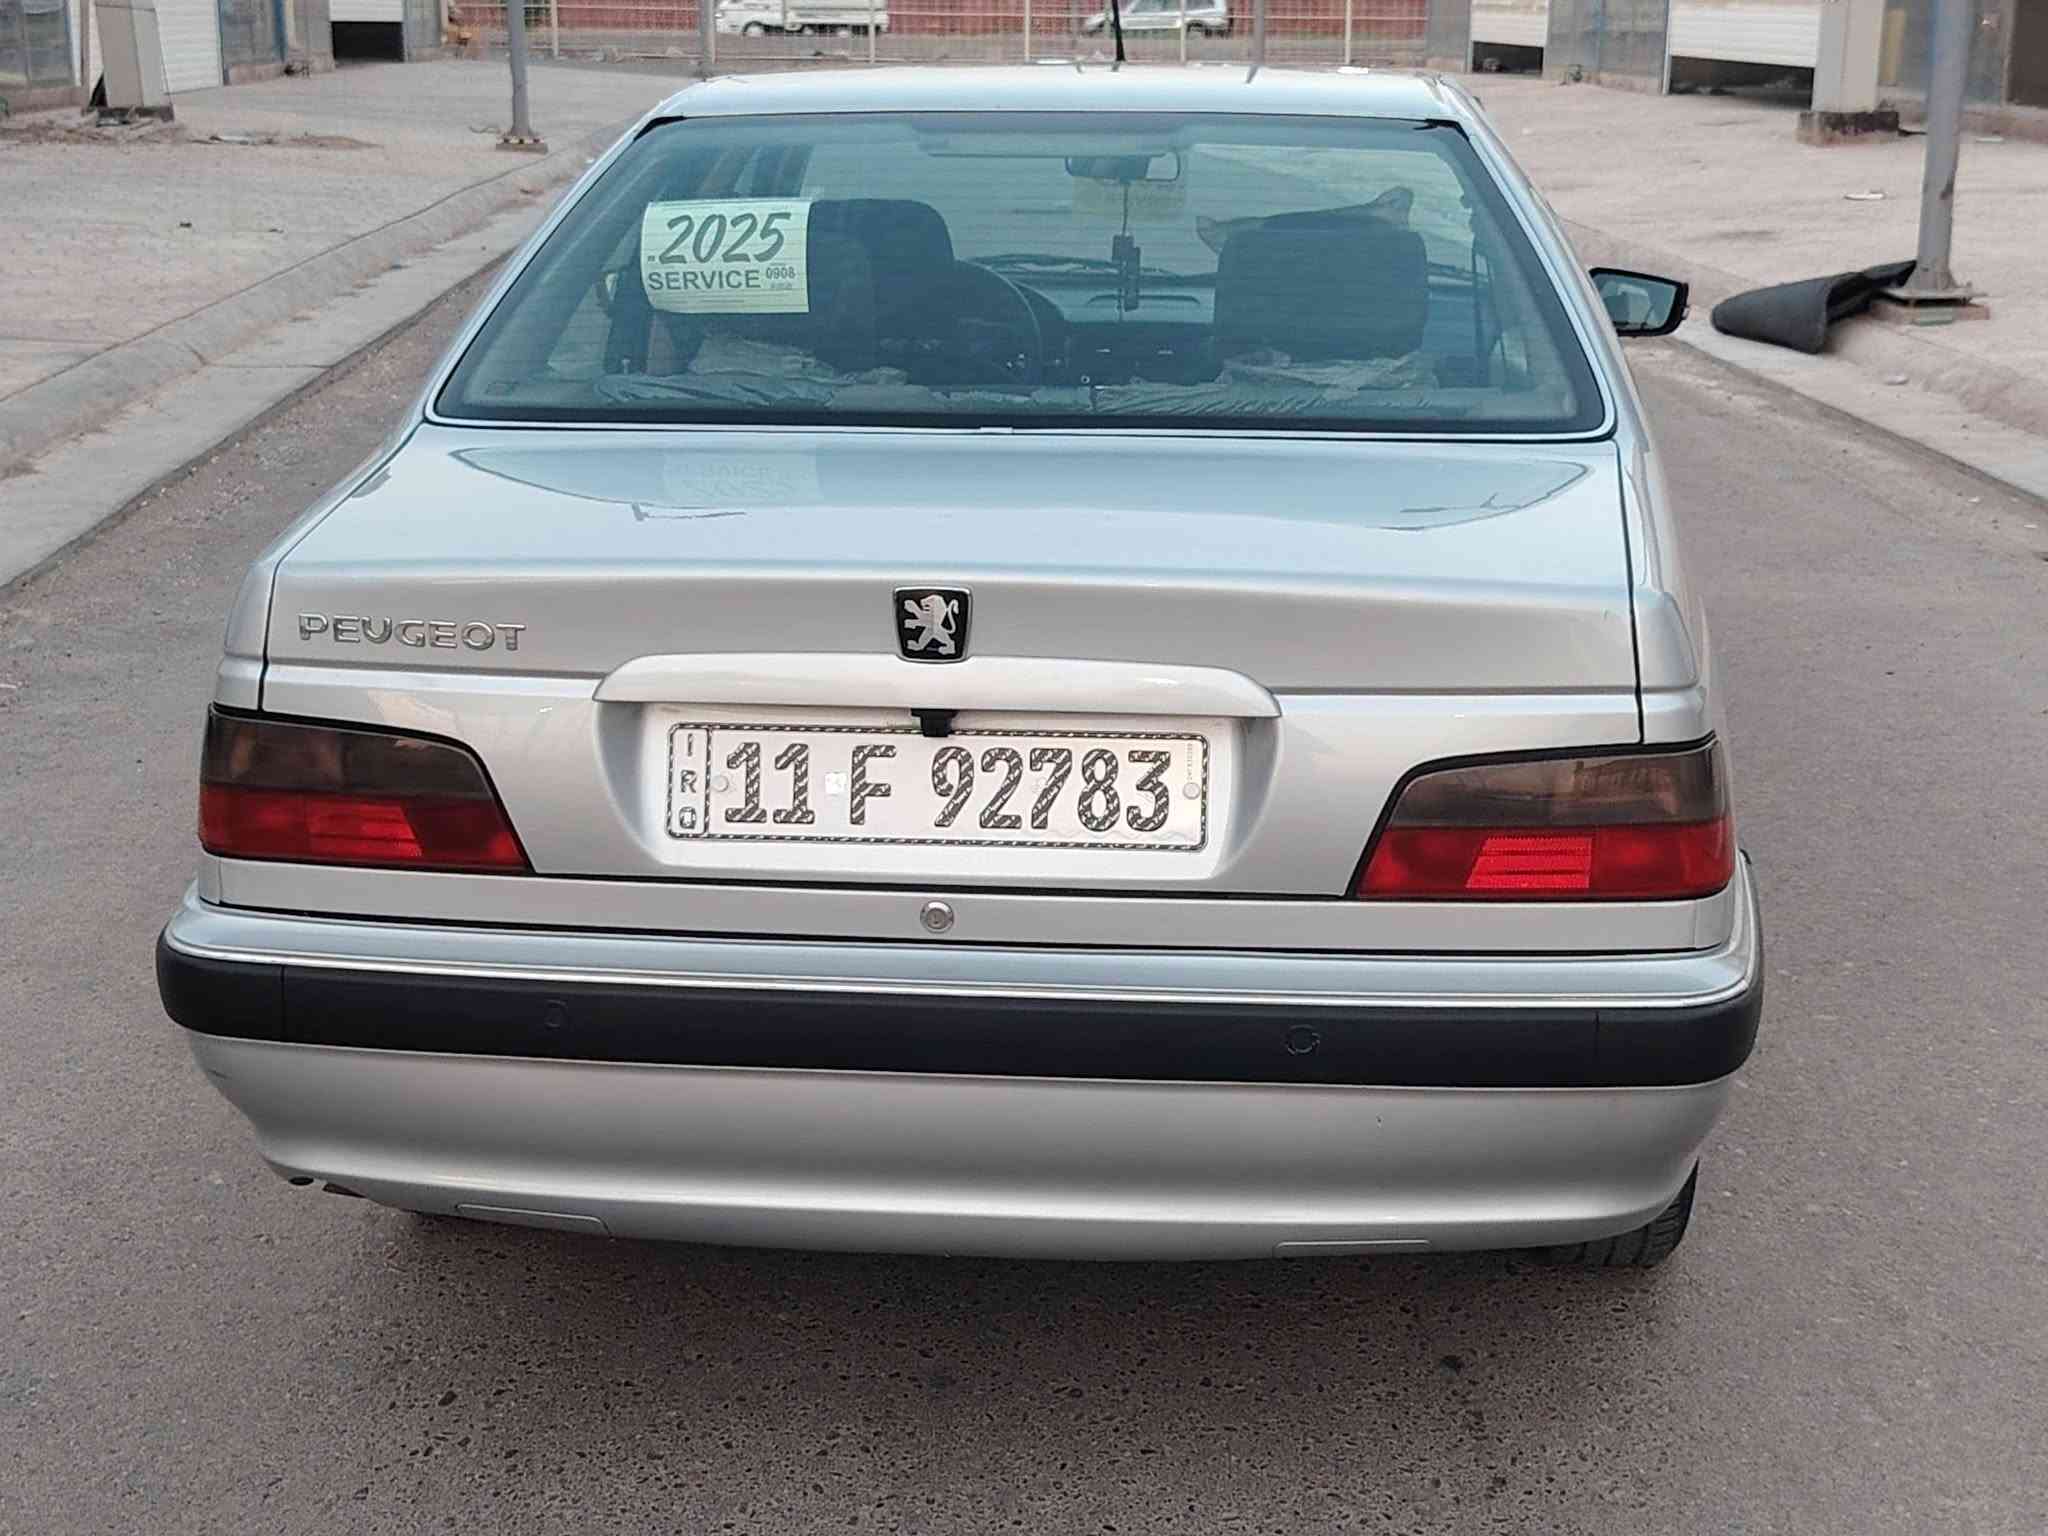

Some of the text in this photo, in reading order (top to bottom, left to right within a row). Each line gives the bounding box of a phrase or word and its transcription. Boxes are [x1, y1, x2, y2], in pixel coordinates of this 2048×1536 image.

[658, 212, 791, 264] 2025
[648, 269, 761, 291] SERVICE
[298, 612, 527, 651] PEUGEOT
[724, 742, 815, 824] 11
[849, 744, 897, 826] F
[931, 745, 1170, 832] 92783
